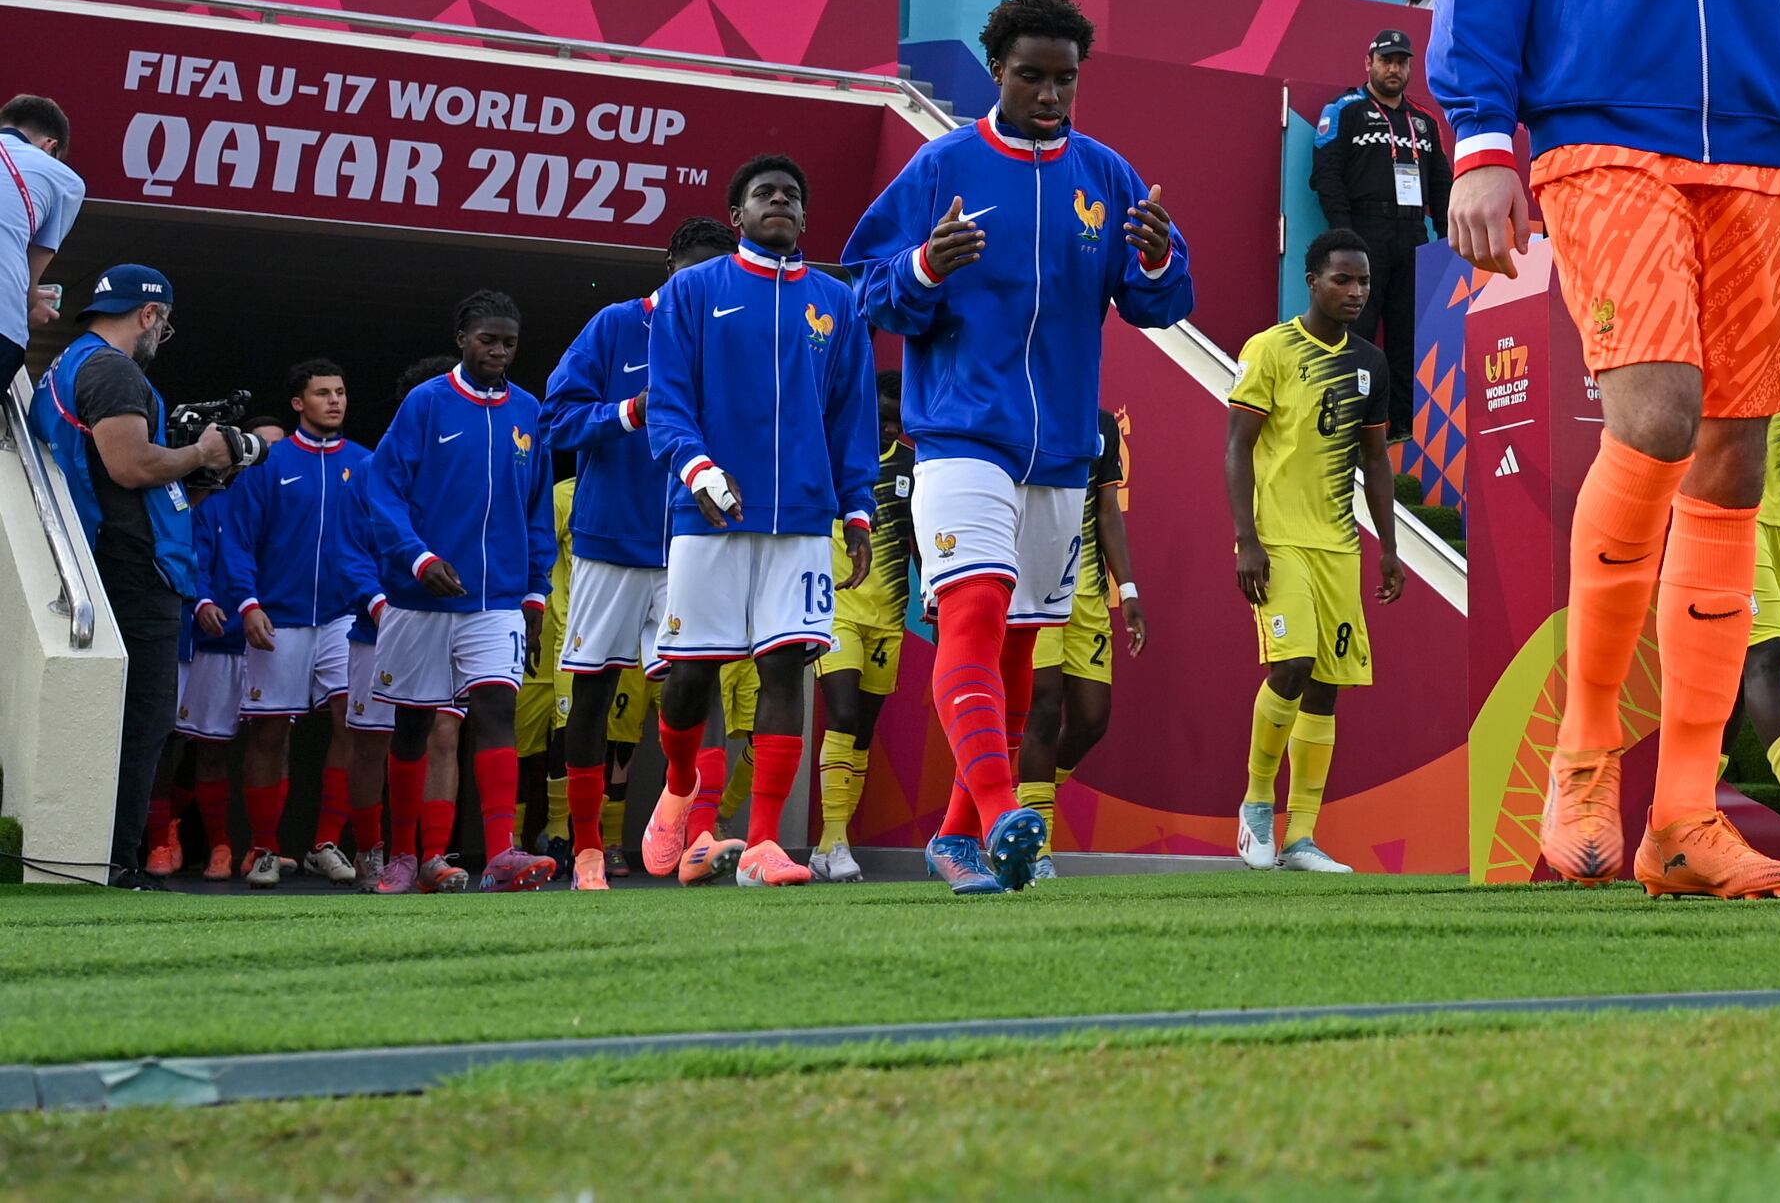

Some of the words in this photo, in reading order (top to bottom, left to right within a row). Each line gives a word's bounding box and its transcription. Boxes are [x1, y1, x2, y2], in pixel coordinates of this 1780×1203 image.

[124, 50, 243, 102] FIFA
[257, 65, 377, 114] U-17
[388, 80, 576, 135] WORLD
[586, 102, 686, 146] CUP
[122, 112, 443, 207] QATAR
[460, 148, 667, 225] 2025
[676, 167, 708, 186] TM
[142, 282, 163, 294] FIFA
[1497, 336, 1515, 351] FIFA
[1485, 345, 1528, 384] U17
[1486, 383, 1512, 400] WORLD
[1513, 379, 1529, 392] CUP
[1487, 396, 1511, 412] QATAR
[1510, 391, 1527, 406] 2025
[1317, 387, 1339, 438] 8
[1059, 535, 1082, 589] 2
[801, 571, 835, 615] 13
[870, 637, 889, 669] 4
[1089, 633, 1107, 666] 2
[1335, 622, 1352, 658] 8
[615, 692, 628, 719] 9
